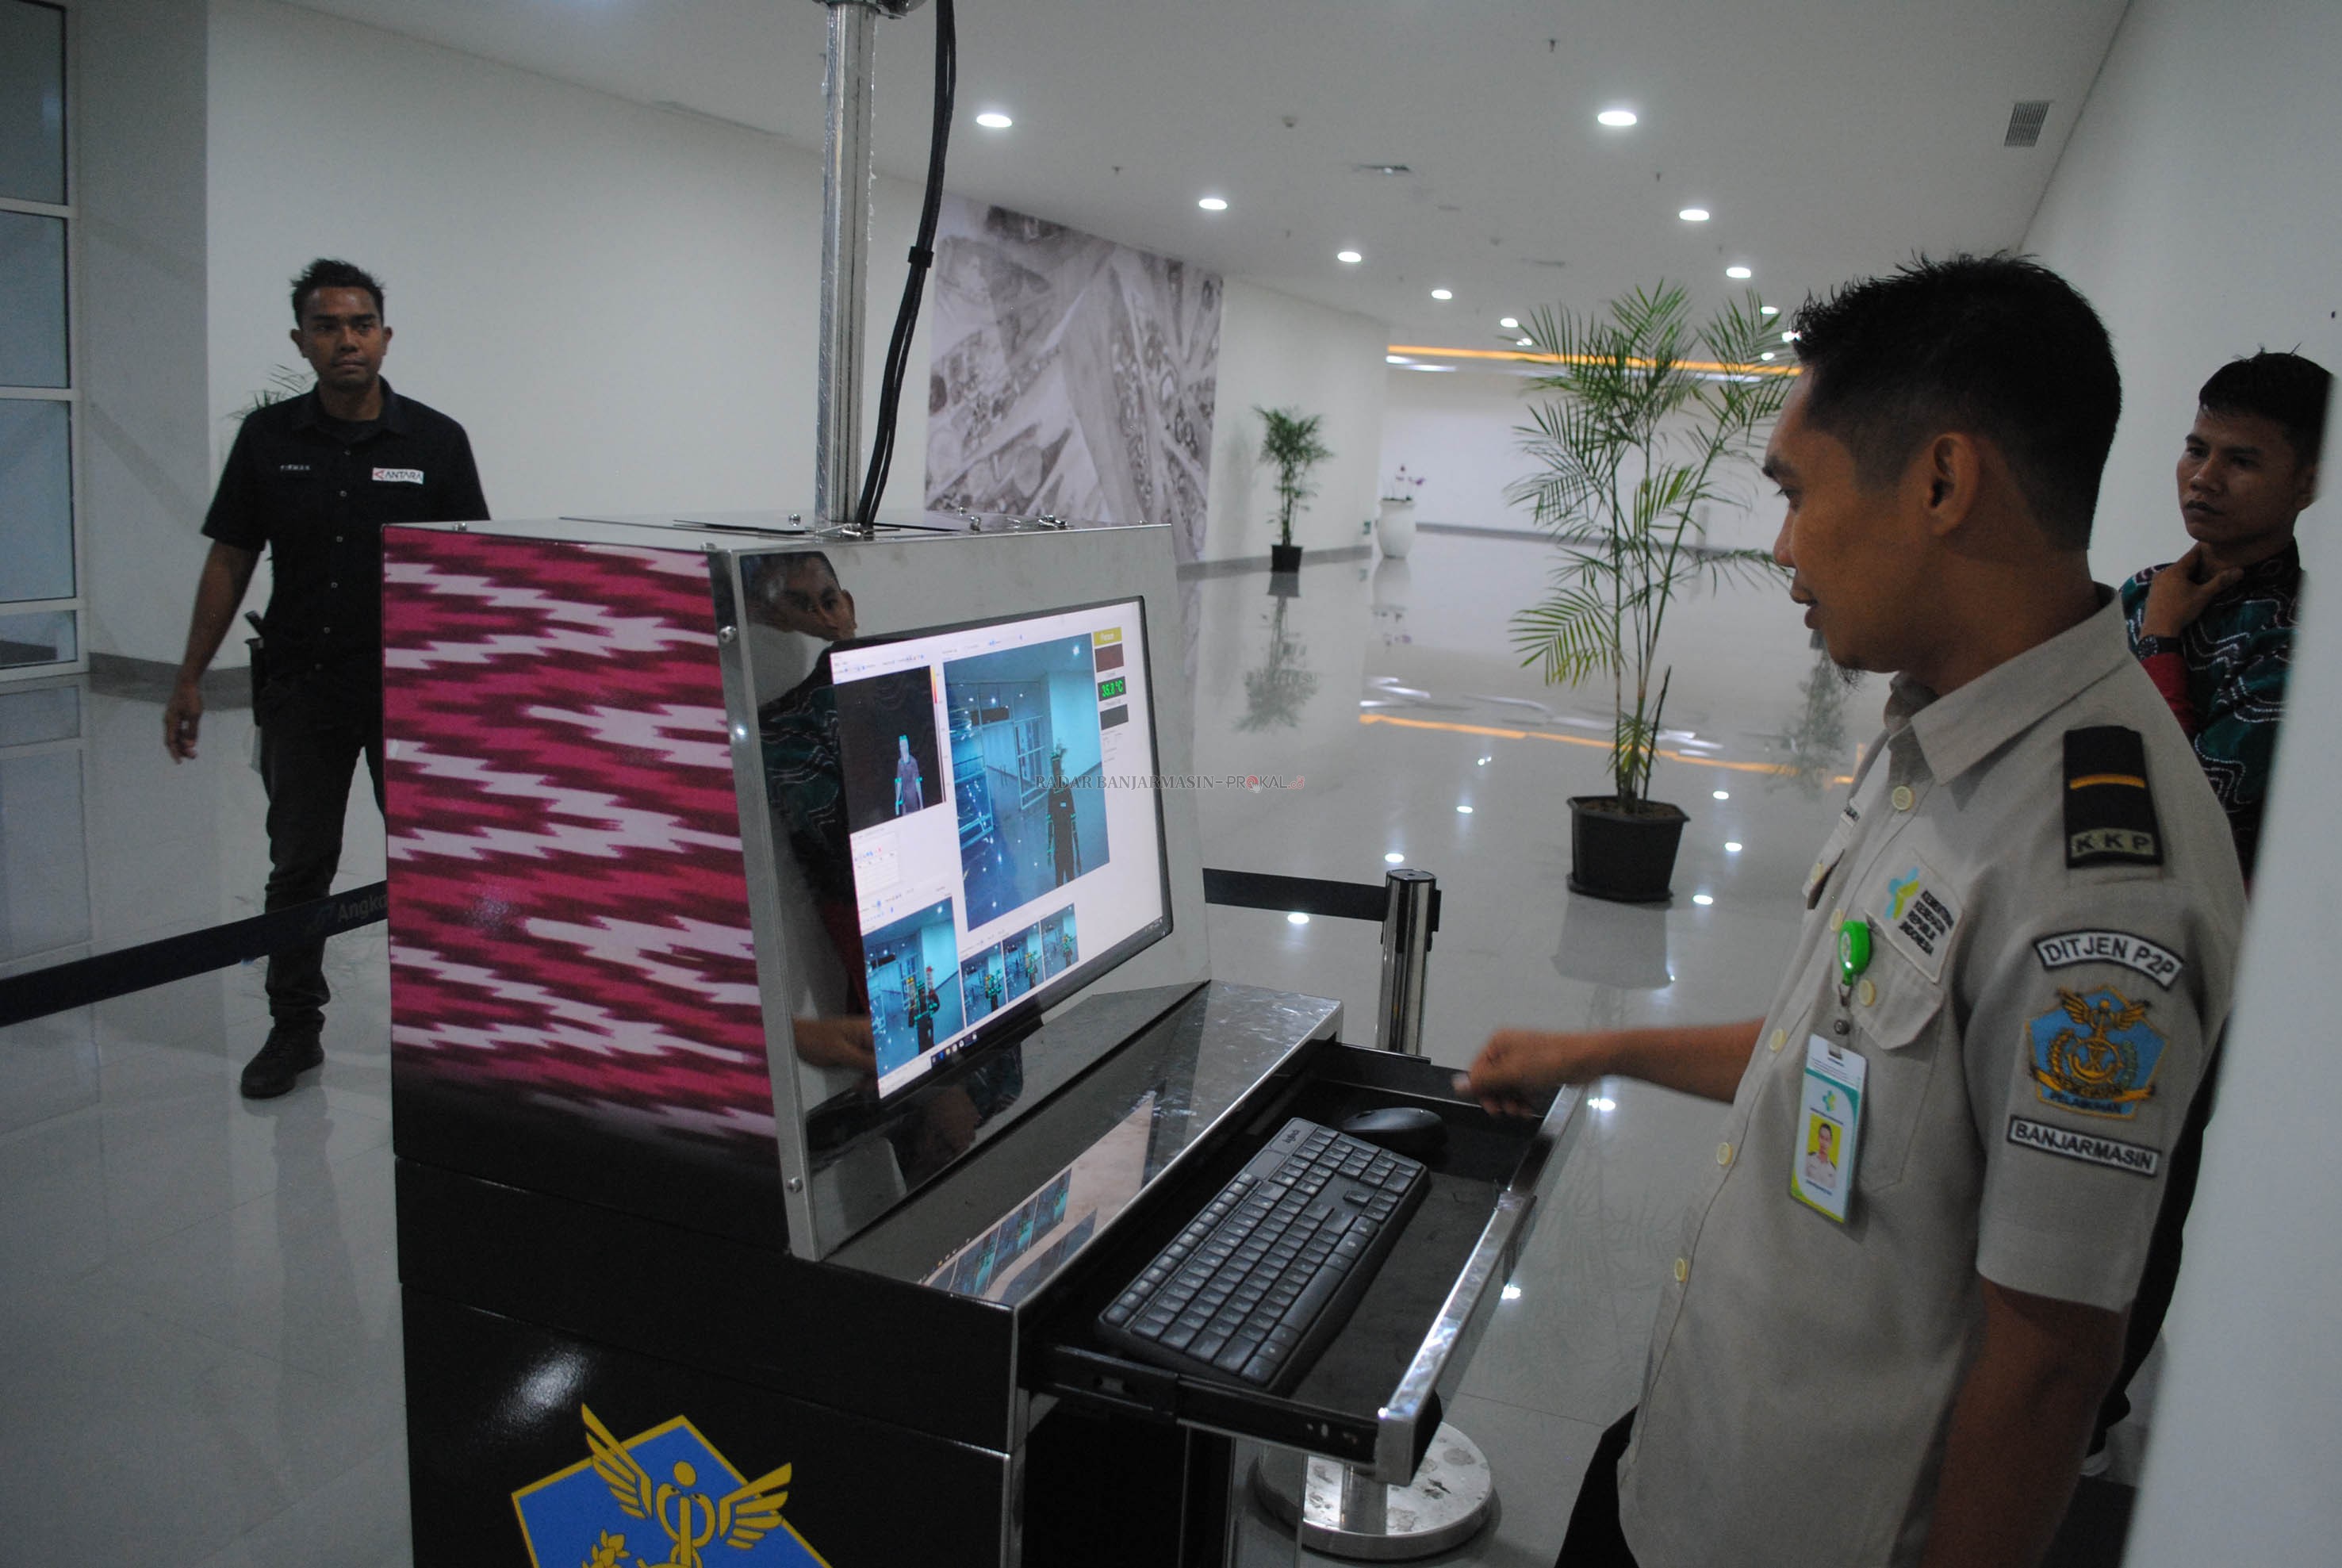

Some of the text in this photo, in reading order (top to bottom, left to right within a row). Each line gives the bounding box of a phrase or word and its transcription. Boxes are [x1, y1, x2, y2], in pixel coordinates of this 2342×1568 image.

[385, 470, 423, 481] ANTARA
[2043, 937, 2175, 975] DITJEN P2P
[2015, 1123, 2153, 1171] BANJARMASIN
